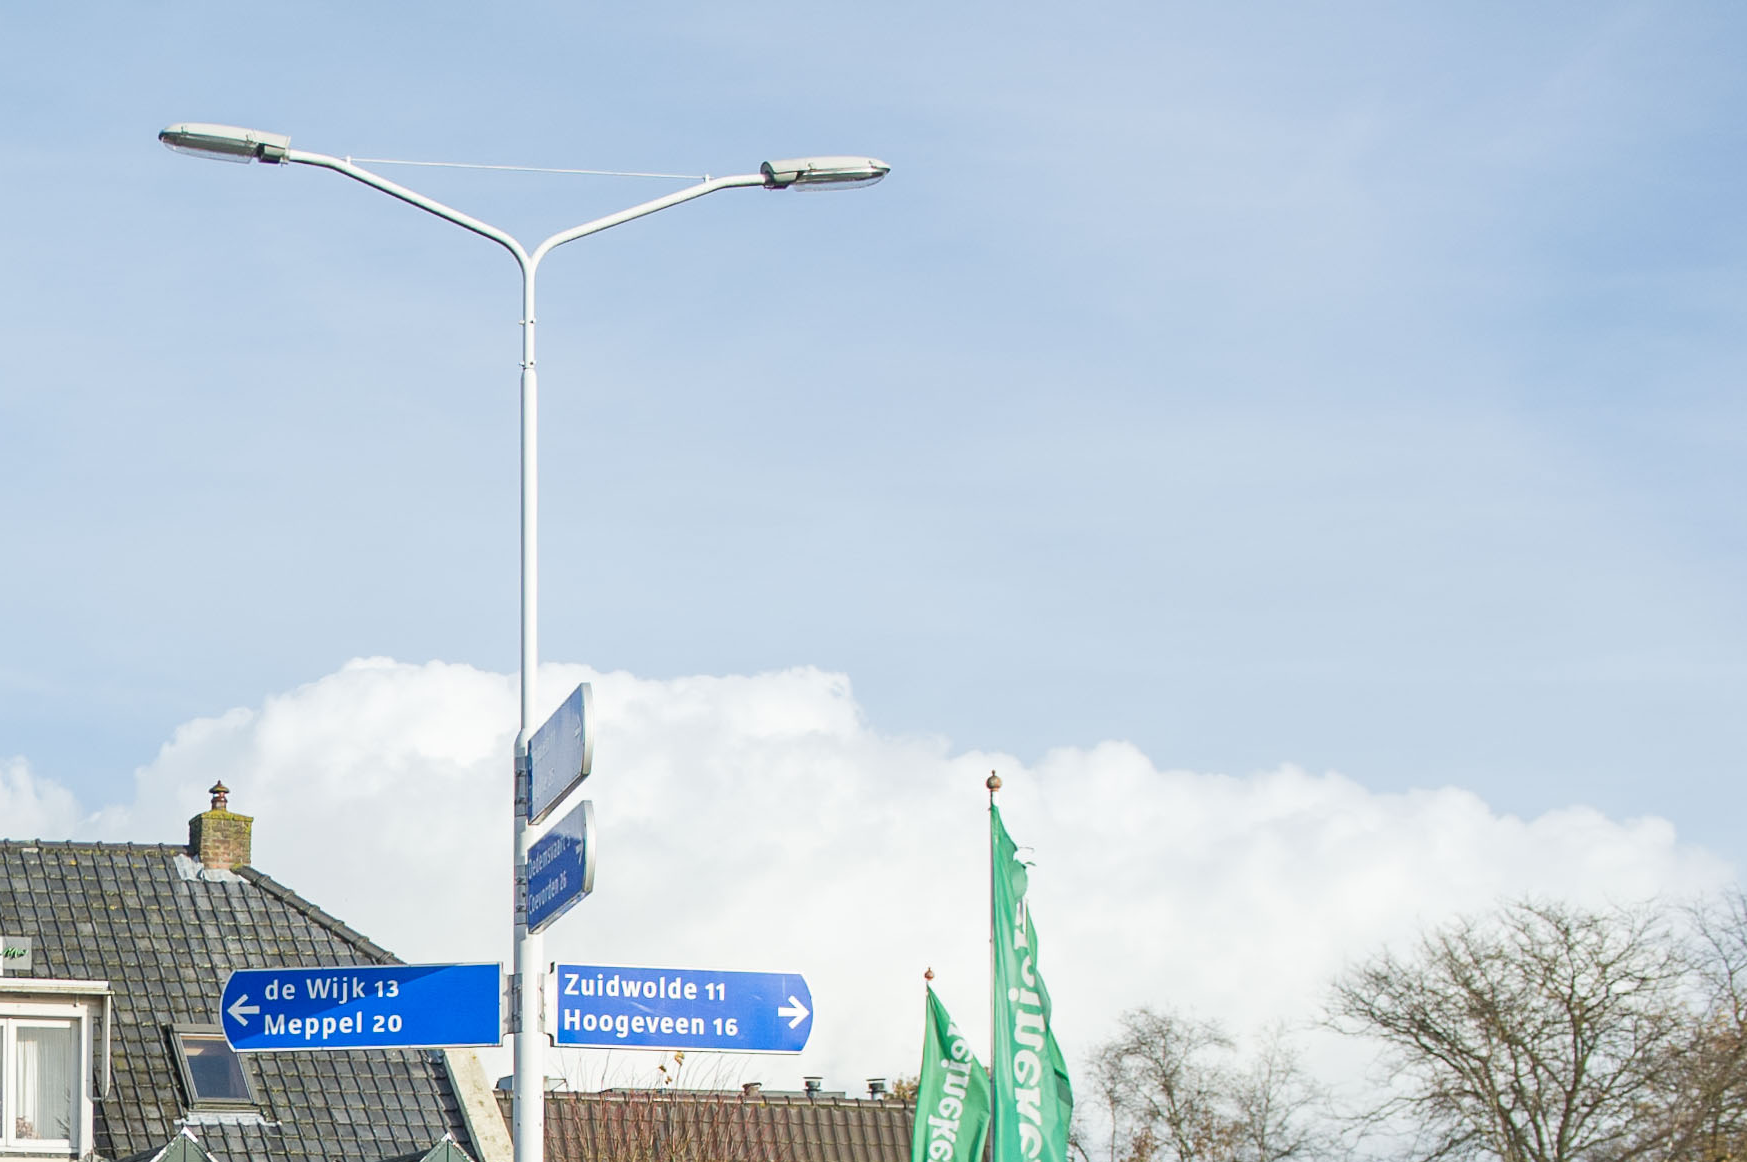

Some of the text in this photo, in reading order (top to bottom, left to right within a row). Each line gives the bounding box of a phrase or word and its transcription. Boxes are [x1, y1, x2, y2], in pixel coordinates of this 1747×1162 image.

[264, 976, 399, 1005] de Wijk 13
[564, 973, 725, 1001] Zuidwolde 11
[264, 1011, 402, 1040] Meppel 20
[564, 1008, 738, 1038] Hoogeveen 16
